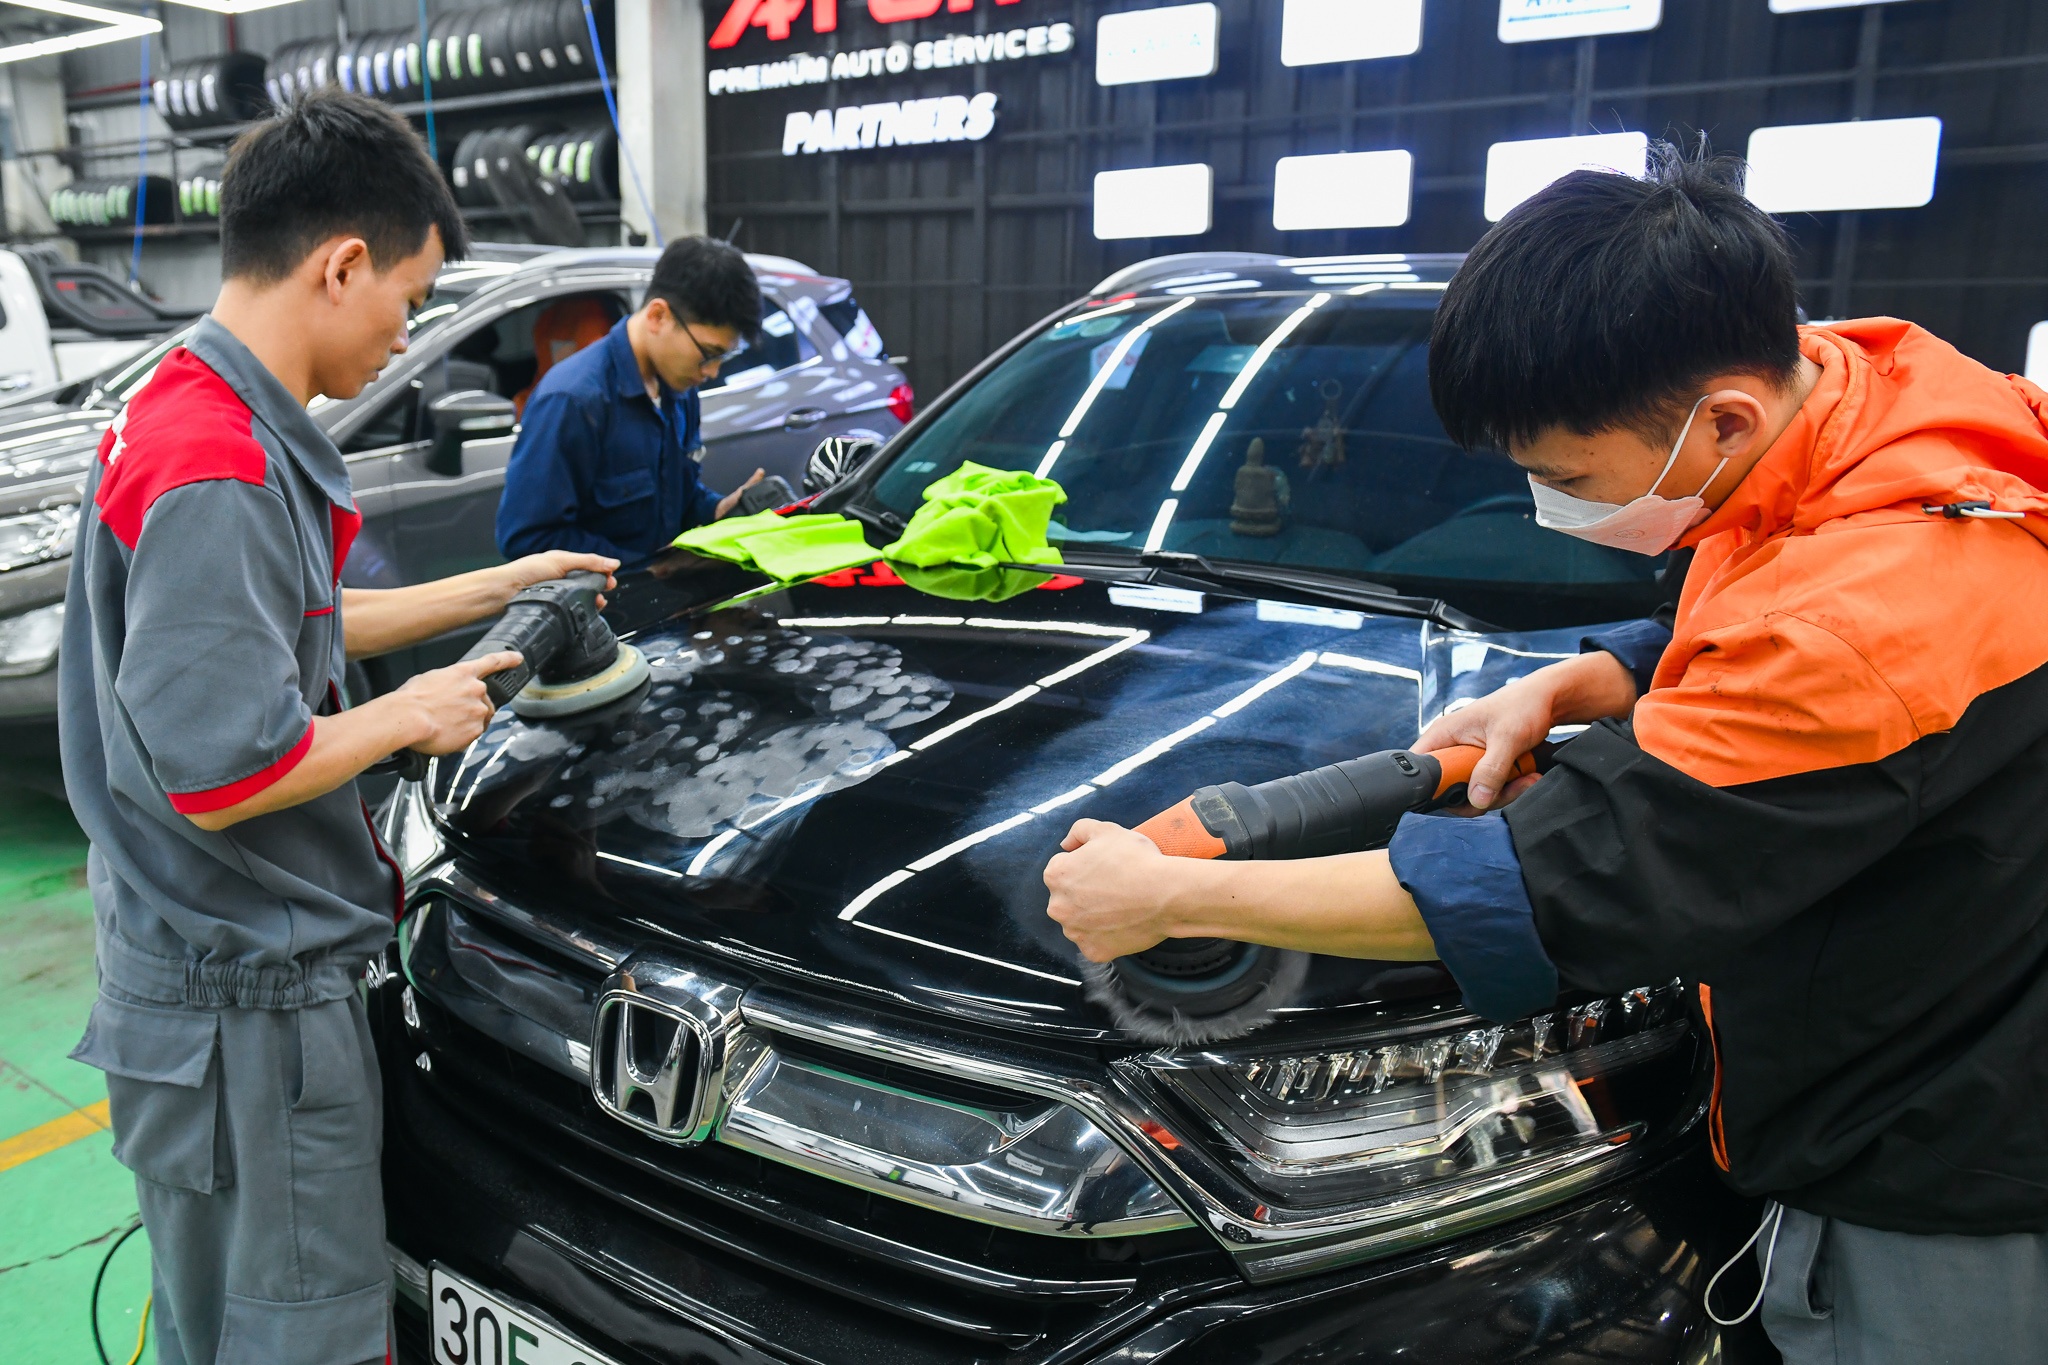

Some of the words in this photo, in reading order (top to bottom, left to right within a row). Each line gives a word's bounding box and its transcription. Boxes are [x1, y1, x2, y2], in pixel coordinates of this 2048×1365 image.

[708, 57, 827, 95] PREMIUM
[831, 45, 909, 79] AUTO
[913, 22, 1074, 70] SERVICES
[782, 91, 999, 156] PARTNERS
